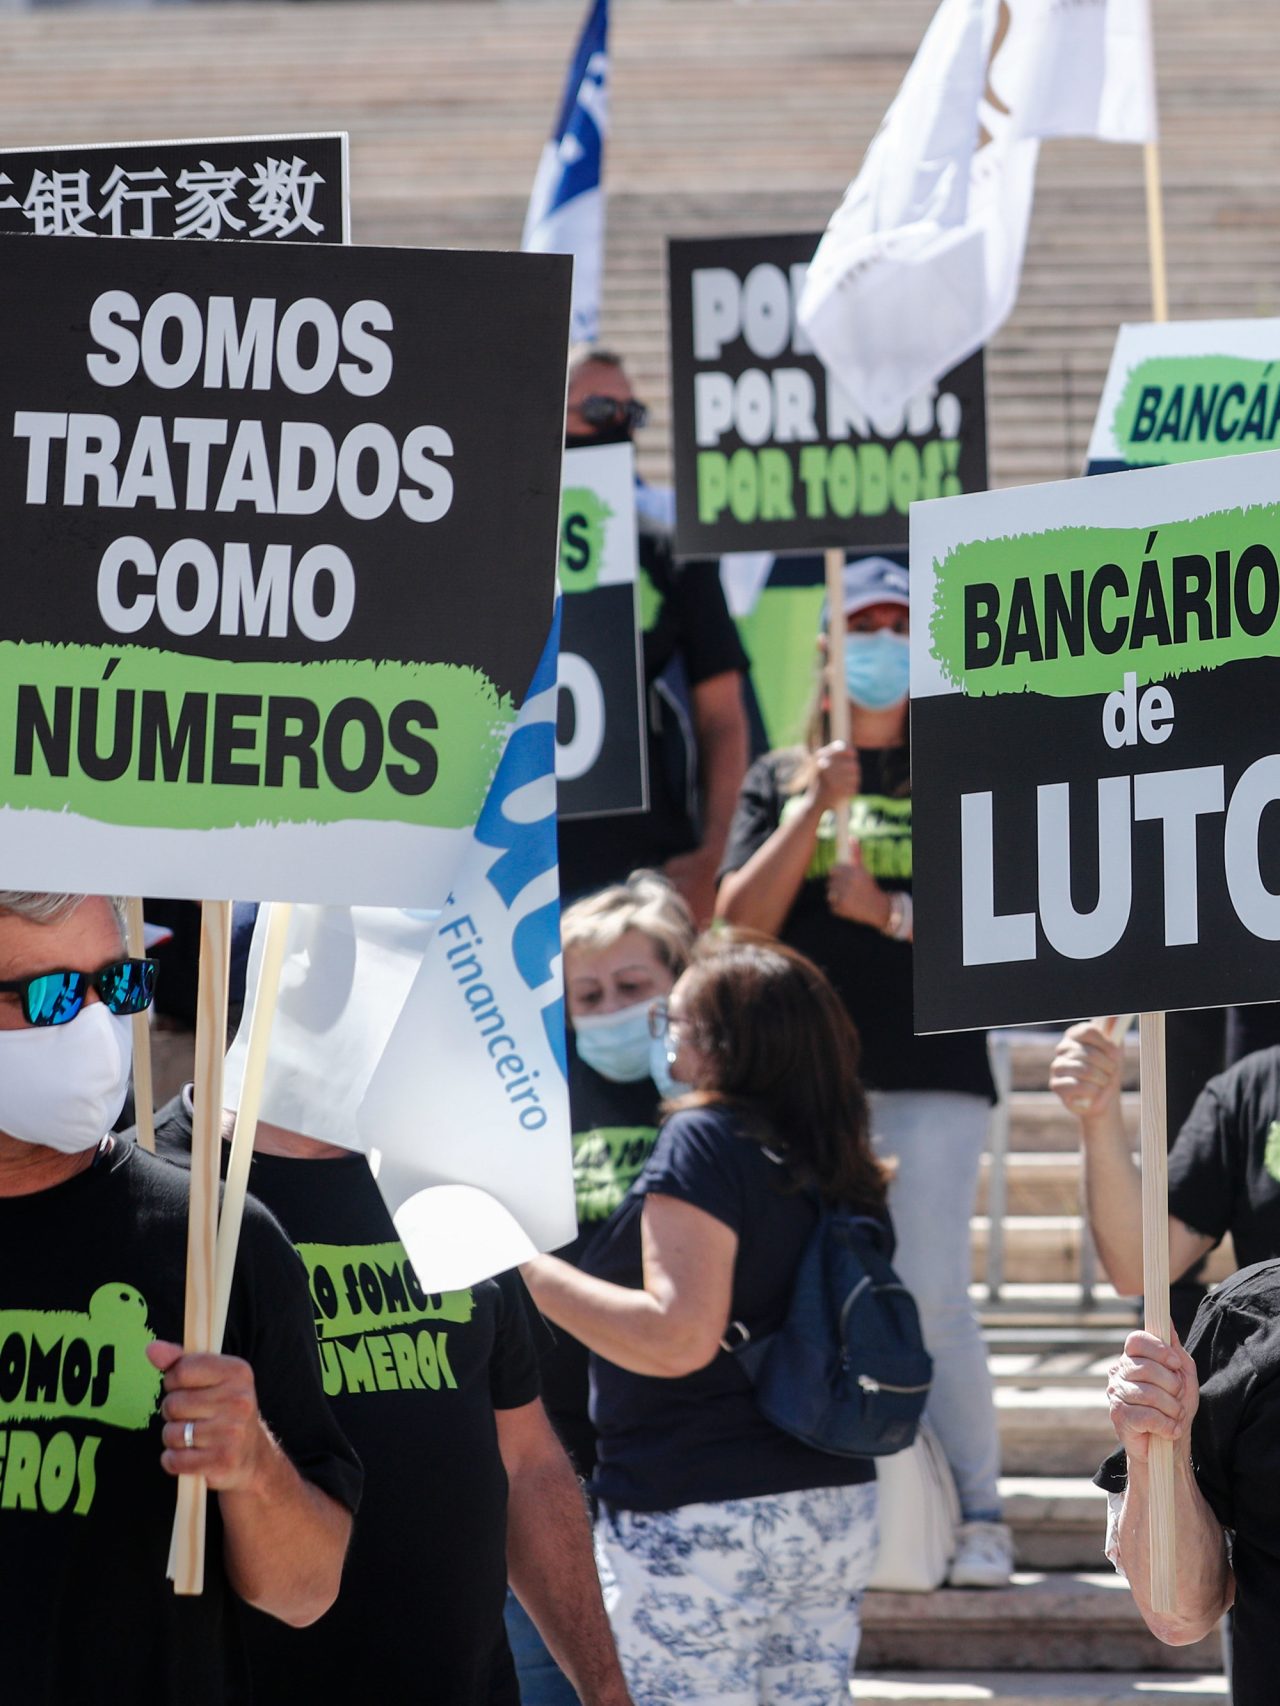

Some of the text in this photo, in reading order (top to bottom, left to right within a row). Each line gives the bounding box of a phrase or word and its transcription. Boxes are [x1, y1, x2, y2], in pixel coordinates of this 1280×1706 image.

[0, 156, 327, 239] 银行家数
[87, 290, 394, 397] SOMOS
[694, 367, 820, 447] POR
[13, 411, 454, 524] TRATADOS
[696, 438, 962, 524] POR TODOS!
[97, 535, 356, 642] COMO
[14, 658, 439, 796] NÚMEROS
[1102, 672, 1175, 750] de
[437, 914, 549, 1133] Financeiro
[0, 1331, 115, 1408] OMOS
[316, 1325, 459, 1397] ÚMEROS
[0, 1430, 103, 1517] ROS
